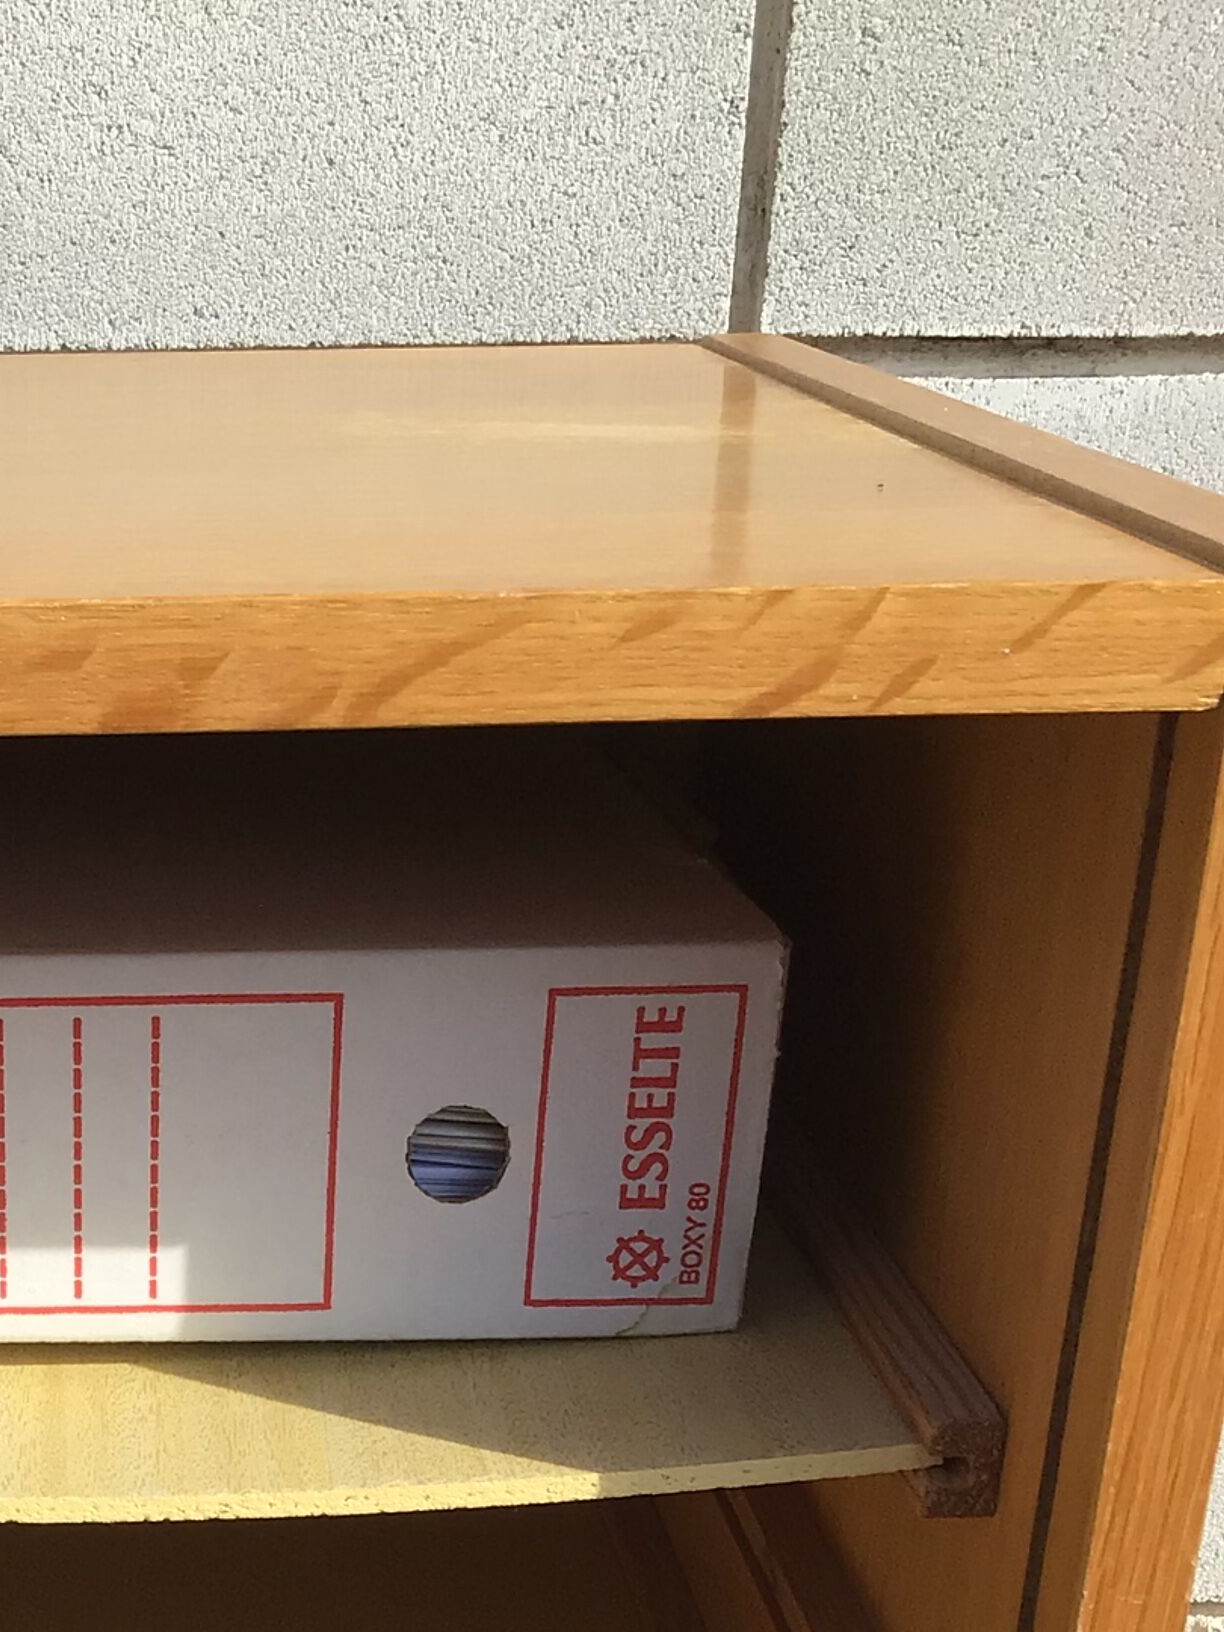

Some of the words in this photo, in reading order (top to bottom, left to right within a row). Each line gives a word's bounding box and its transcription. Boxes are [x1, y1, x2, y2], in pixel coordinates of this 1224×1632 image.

[618, 1005, 686, 1210] ESSELTE
[686, 1182, 711, 1211] 80
[678, 1215, 708, 1285] BOXY
